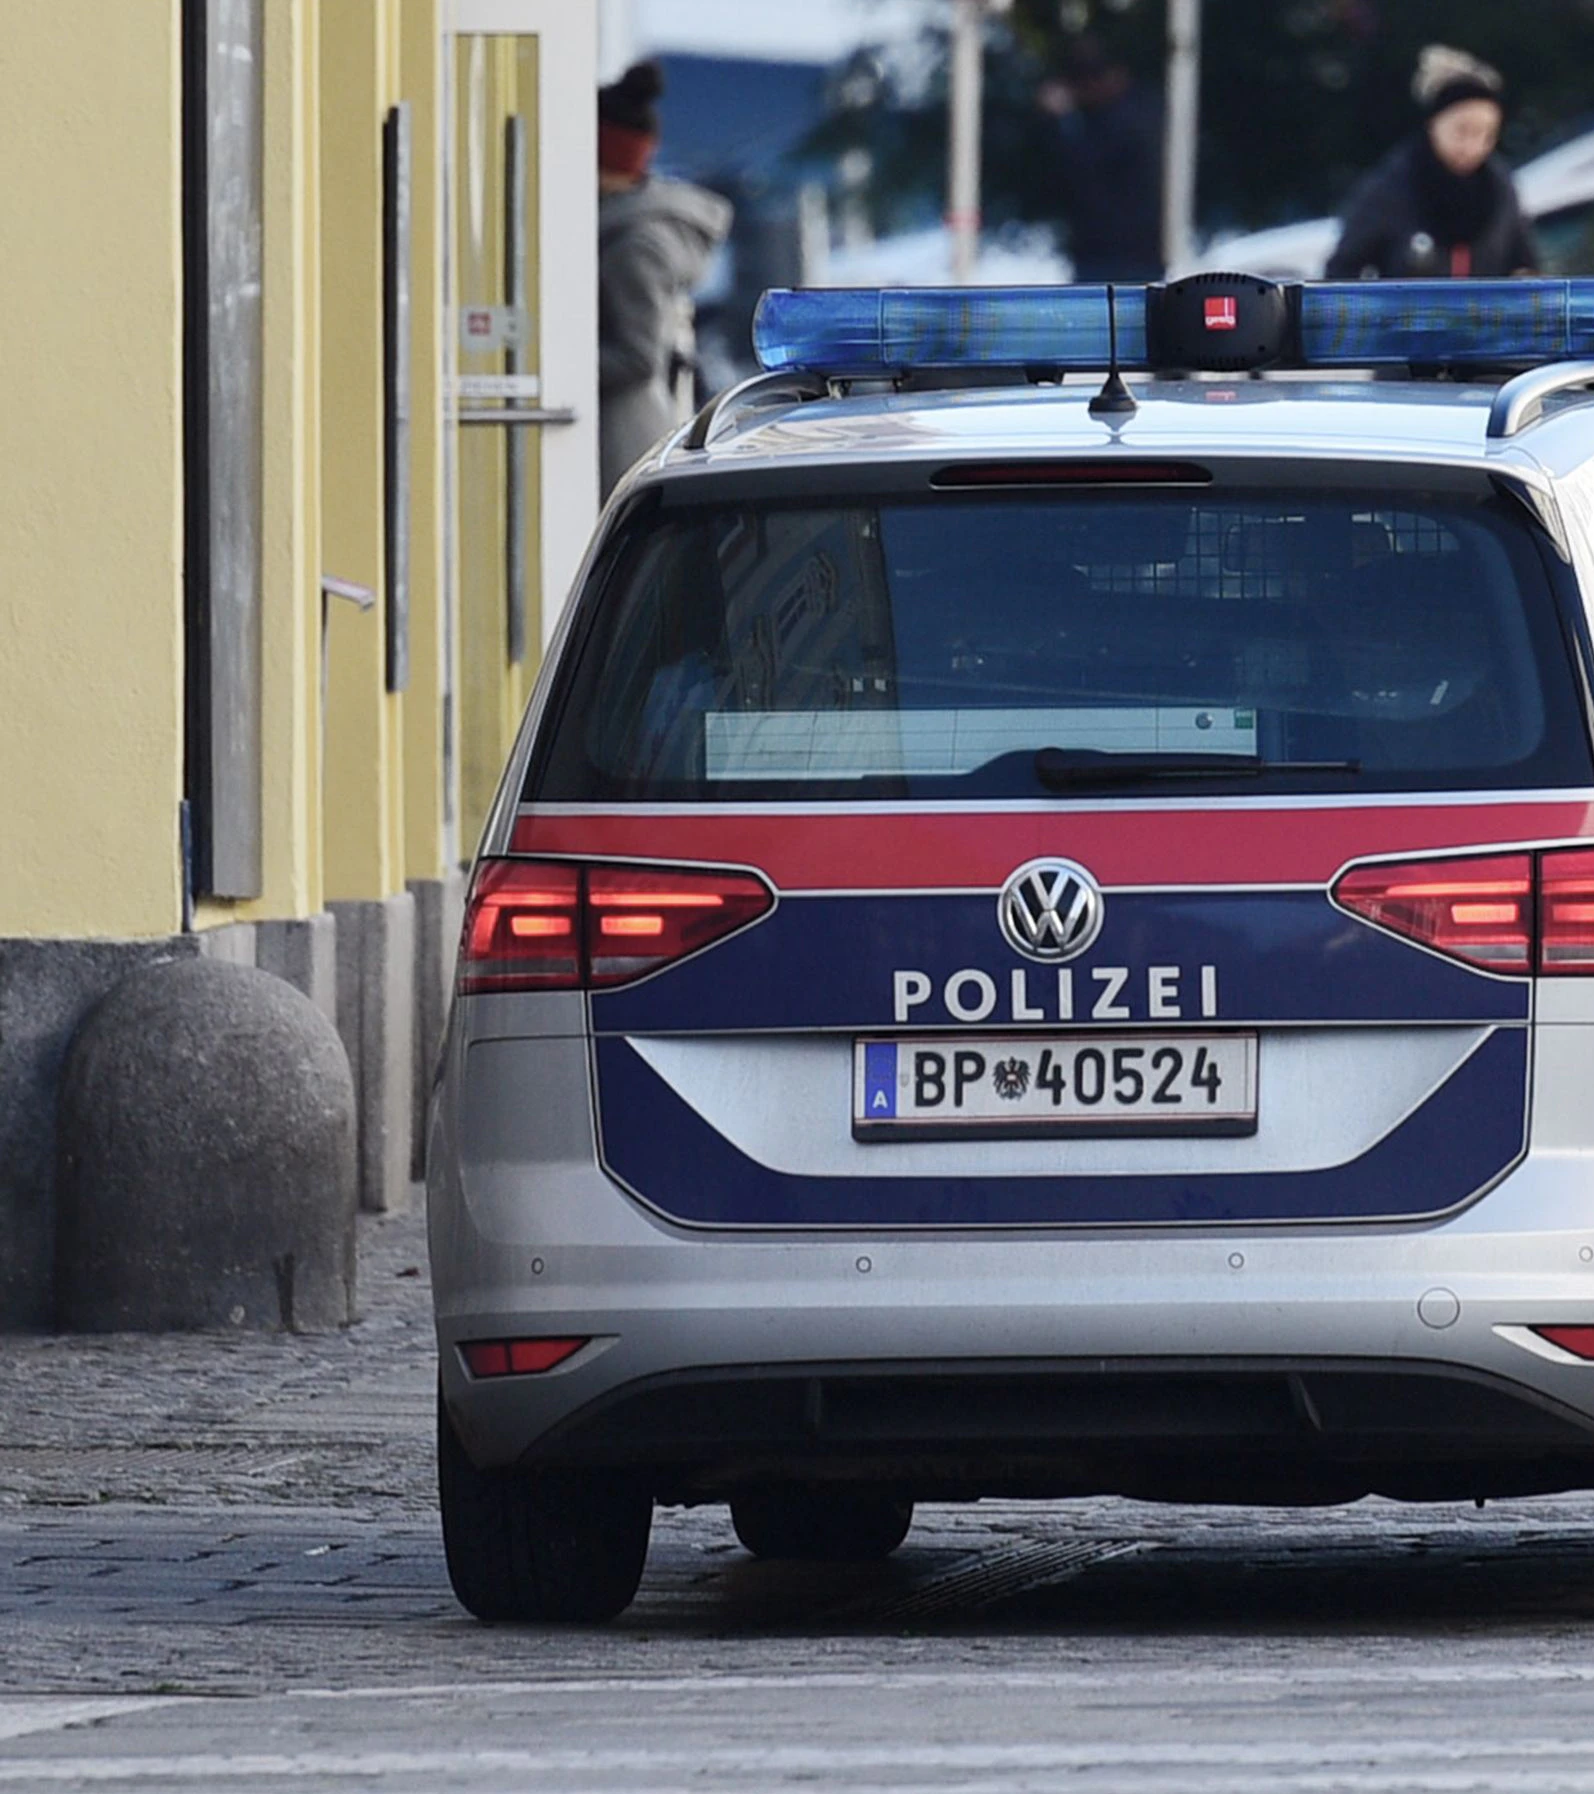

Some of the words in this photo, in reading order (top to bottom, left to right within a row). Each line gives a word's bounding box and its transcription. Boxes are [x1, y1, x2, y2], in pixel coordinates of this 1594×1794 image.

[893, 965, 1217, 1022] POLIZEI
[872, 1089, 888, 1108] A
[914, 1050, 986, 1108] BP
[1035, 1046, 1222, 1106] 40524
